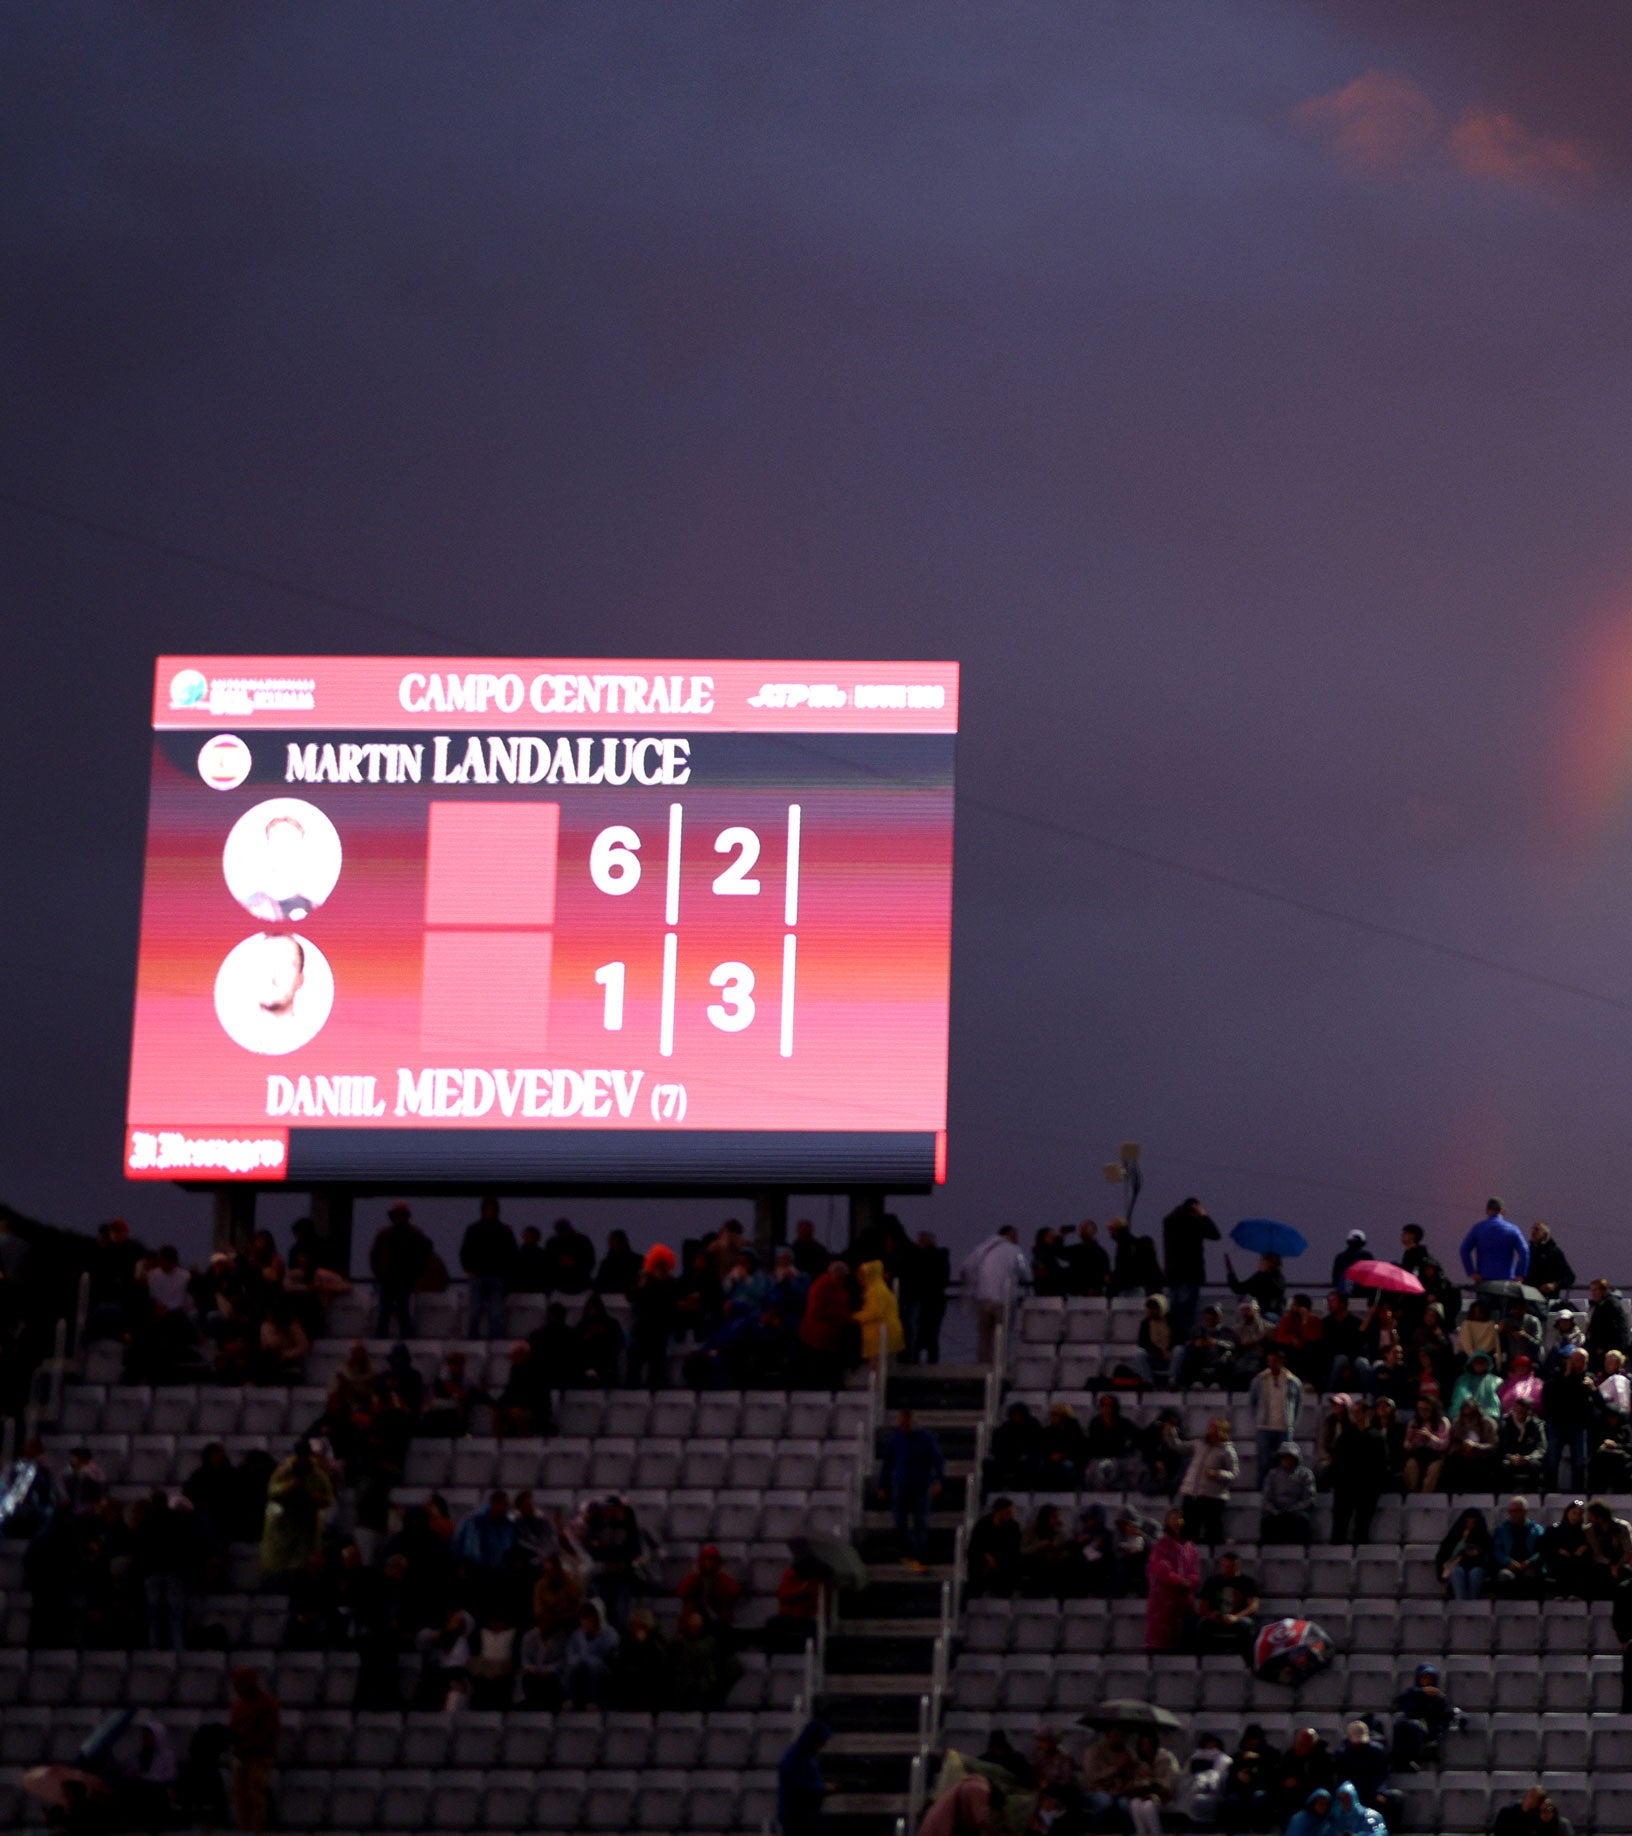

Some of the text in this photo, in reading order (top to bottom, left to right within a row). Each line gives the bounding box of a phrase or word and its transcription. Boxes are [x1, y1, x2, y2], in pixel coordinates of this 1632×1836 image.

[398, 672, 715, 715] CAMPO CENTRALE
[285, 736, 691, 786] MARTIN LANDALUCE
[590, 825, 761, 896] 6 2
[595, 961, 756, 1032] 1 3
[265, 1067, 688, 1122] DANIIL MEDVEDEV (7)
